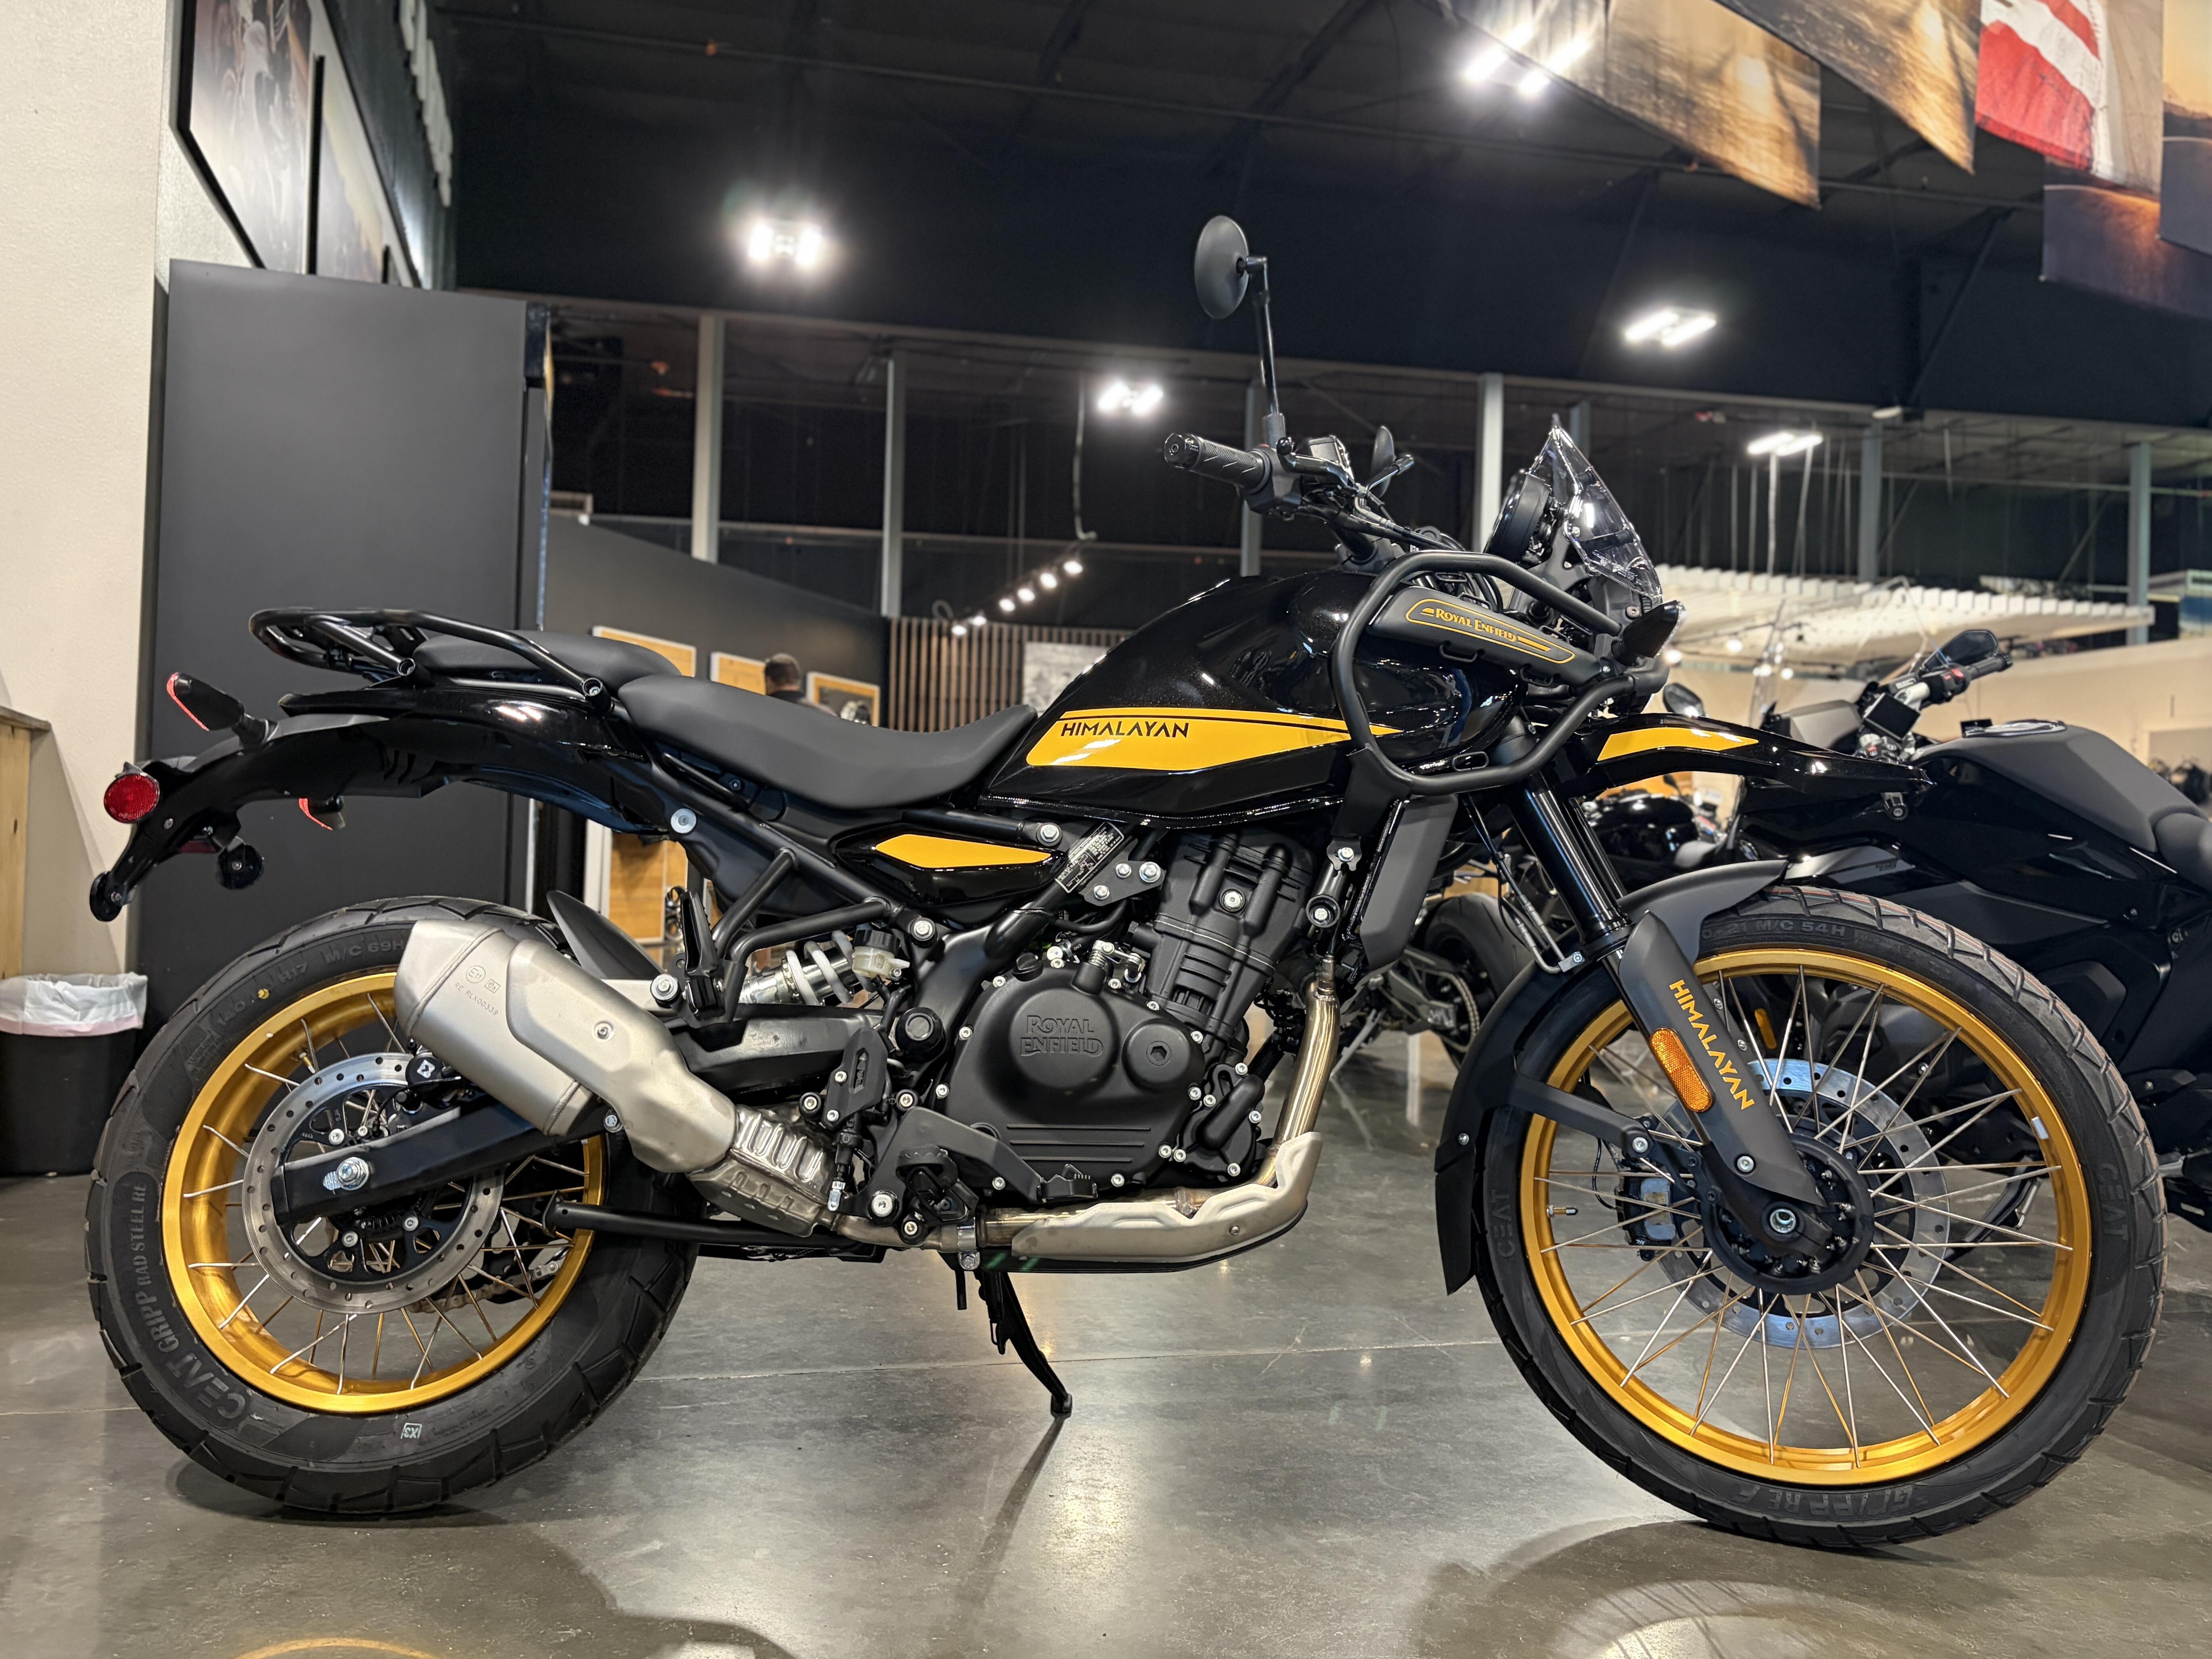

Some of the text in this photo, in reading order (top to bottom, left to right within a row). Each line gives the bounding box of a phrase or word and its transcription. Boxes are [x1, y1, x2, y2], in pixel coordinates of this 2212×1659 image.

[1436, 607, 1518, 642] ROYAL ENFIELD
[1060, 721, 1189, 738] HIMALAYAN
[1756, 920, 1793, 931] M/C
[1802, 921, 1845, 937] 54H
[1026, 1015, 1094, 1036] ROYAL
[1669, 979, 1755, 1110] HIMALAYAN
[1020, 1037, 1104, 1057] ENFIELD
[2098, 1162, 2128, 1241] CEAT
[130, 1205, 145, 1251] STEEL
[1491, 1190, 1515, 1257] CEAT
[133, 1255, 151, 1286] RAD
[136, 1291, 179, 1353] GRIPP
[165, 1353, 245, 1420] CEAT
